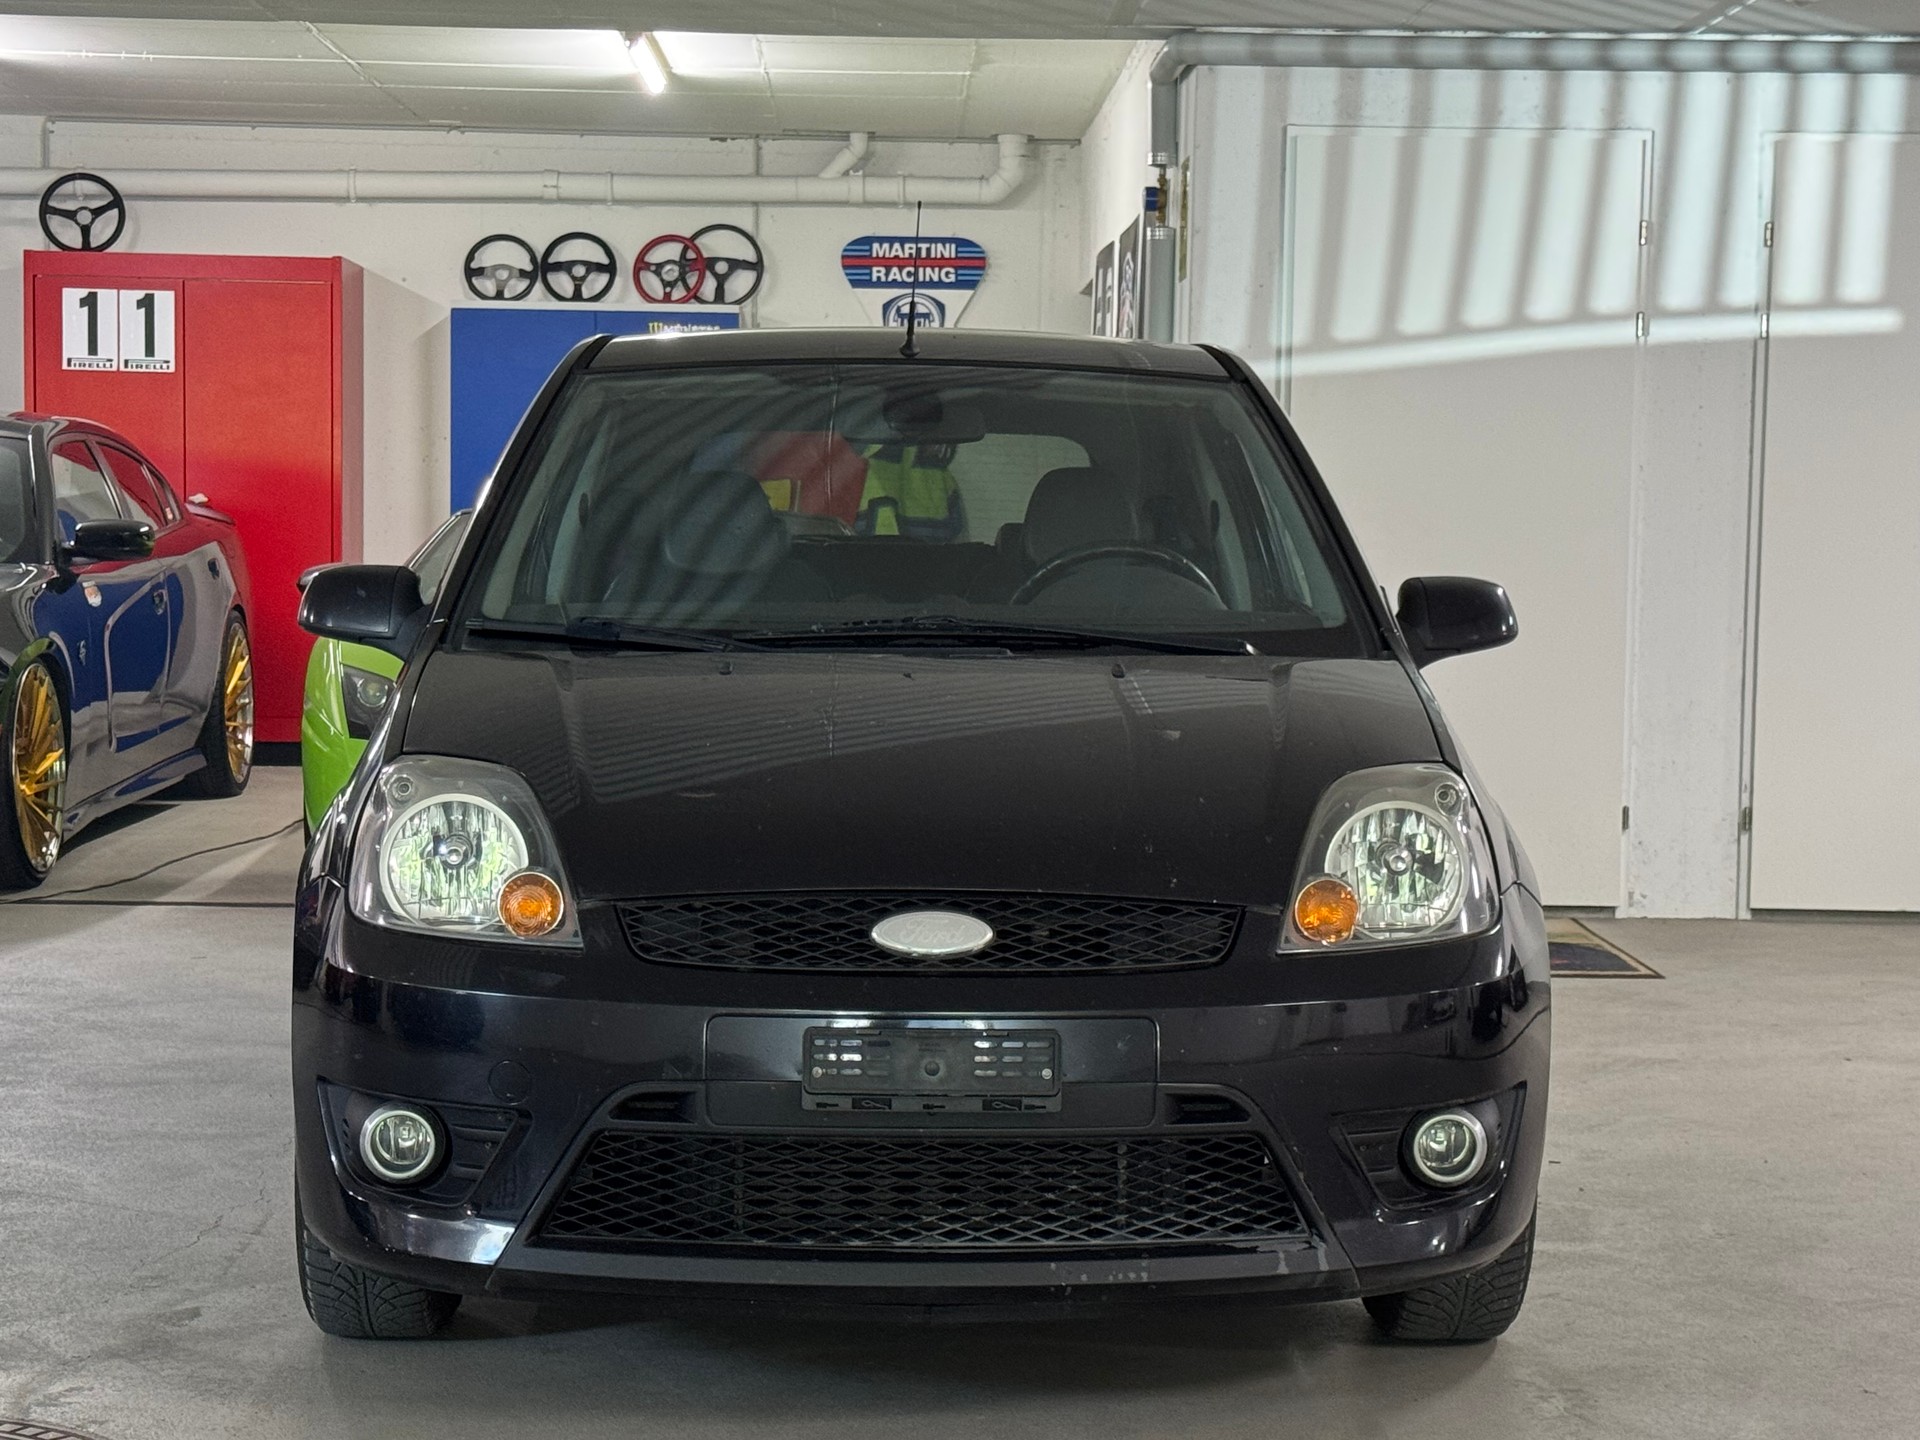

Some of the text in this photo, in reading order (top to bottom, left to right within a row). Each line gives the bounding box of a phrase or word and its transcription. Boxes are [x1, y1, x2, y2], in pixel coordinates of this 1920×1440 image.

[872, 242, 957, 259] MARTINI
[871, 266, 957, 283] RACING
[67, 357, 114, 369] PIRELLI
[124, 358, 171, 371] PIRELLI
[899, 917, 966, 944] Ford
